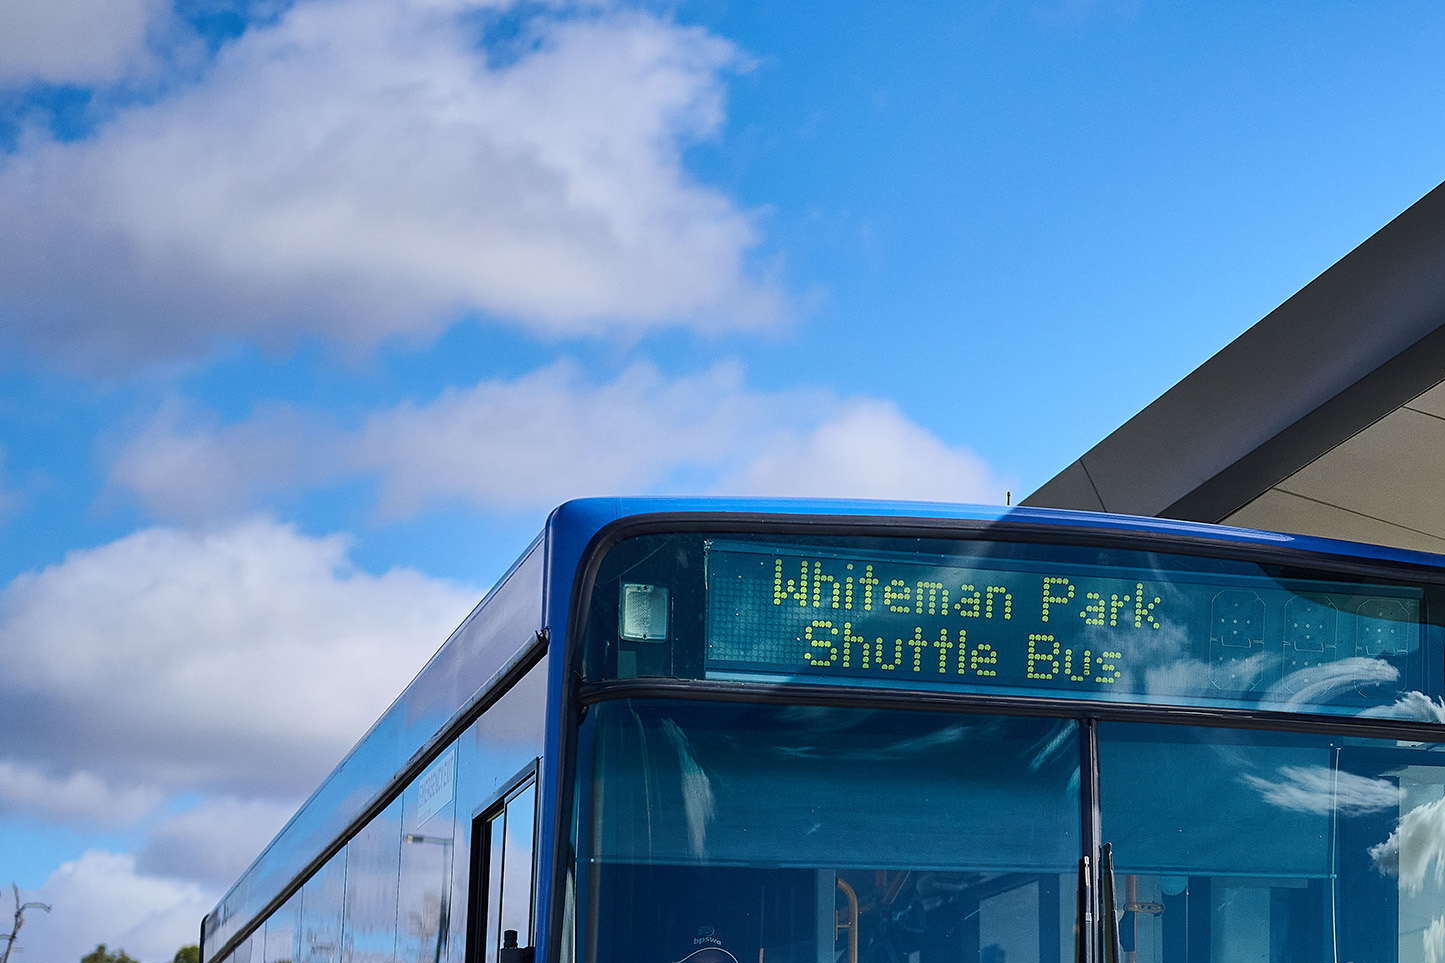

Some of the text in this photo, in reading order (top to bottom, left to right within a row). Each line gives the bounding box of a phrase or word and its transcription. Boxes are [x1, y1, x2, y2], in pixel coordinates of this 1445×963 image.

[773, 558, 1162, 629] Whiteman Park
[804, 620, 1123, 683] Shuttle Bus
